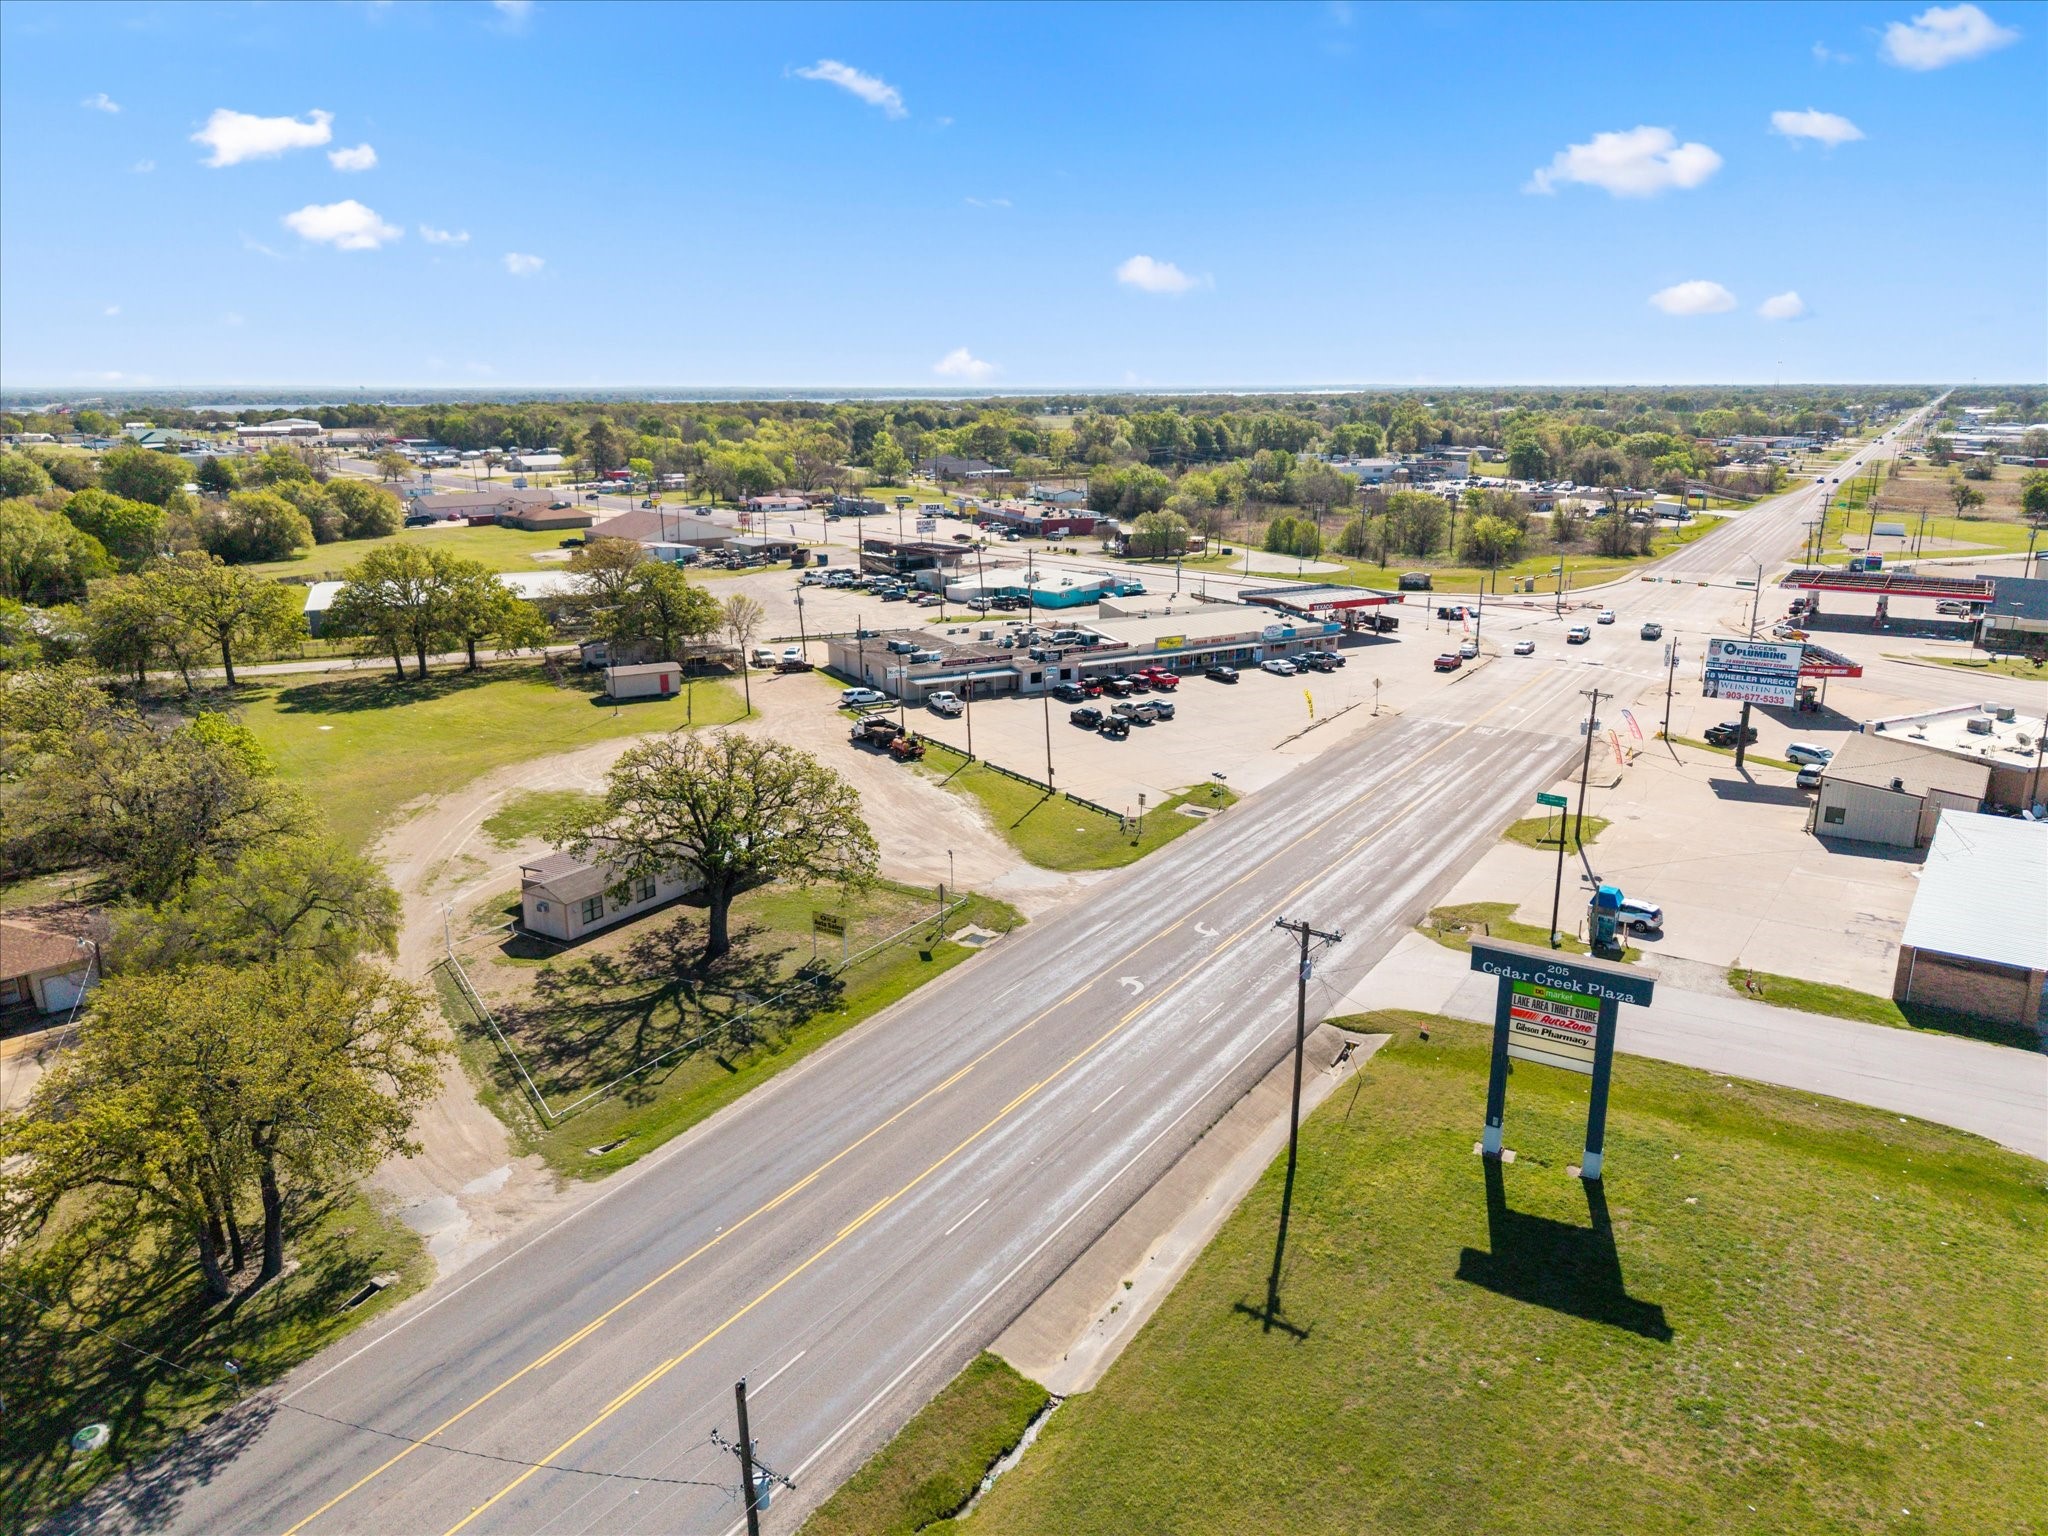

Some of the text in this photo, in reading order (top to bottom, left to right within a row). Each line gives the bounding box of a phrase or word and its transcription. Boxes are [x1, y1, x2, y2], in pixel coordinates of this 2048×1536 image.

[1748, 644, 1777, 652] ACCESS
[1736, 649, 1787, 660] PLUMBING
[1745, 660, 1773, 668] EMERGENCY
[1718, 673, 1757, 682] WHEELER
[1760, 677, 1795, 686] WRECK?
[1720, 681, 1770, 693] WEINSTEIN
[1726, 691, 1785, 704] 903-677-5333
[1547, 965, 1569, 976] 205
[1482, 961, 1635, 1004] Cedar Creek Plaza
[1545, 990, 1573, 1001] market
[1513, 995, 1597, 1021] LAKE AREA THRIFT STORE
[1540, 1014, 1594, 1033] AutoZone
[1515, 1021, 1590, 1046] Gibson Pharmacy
